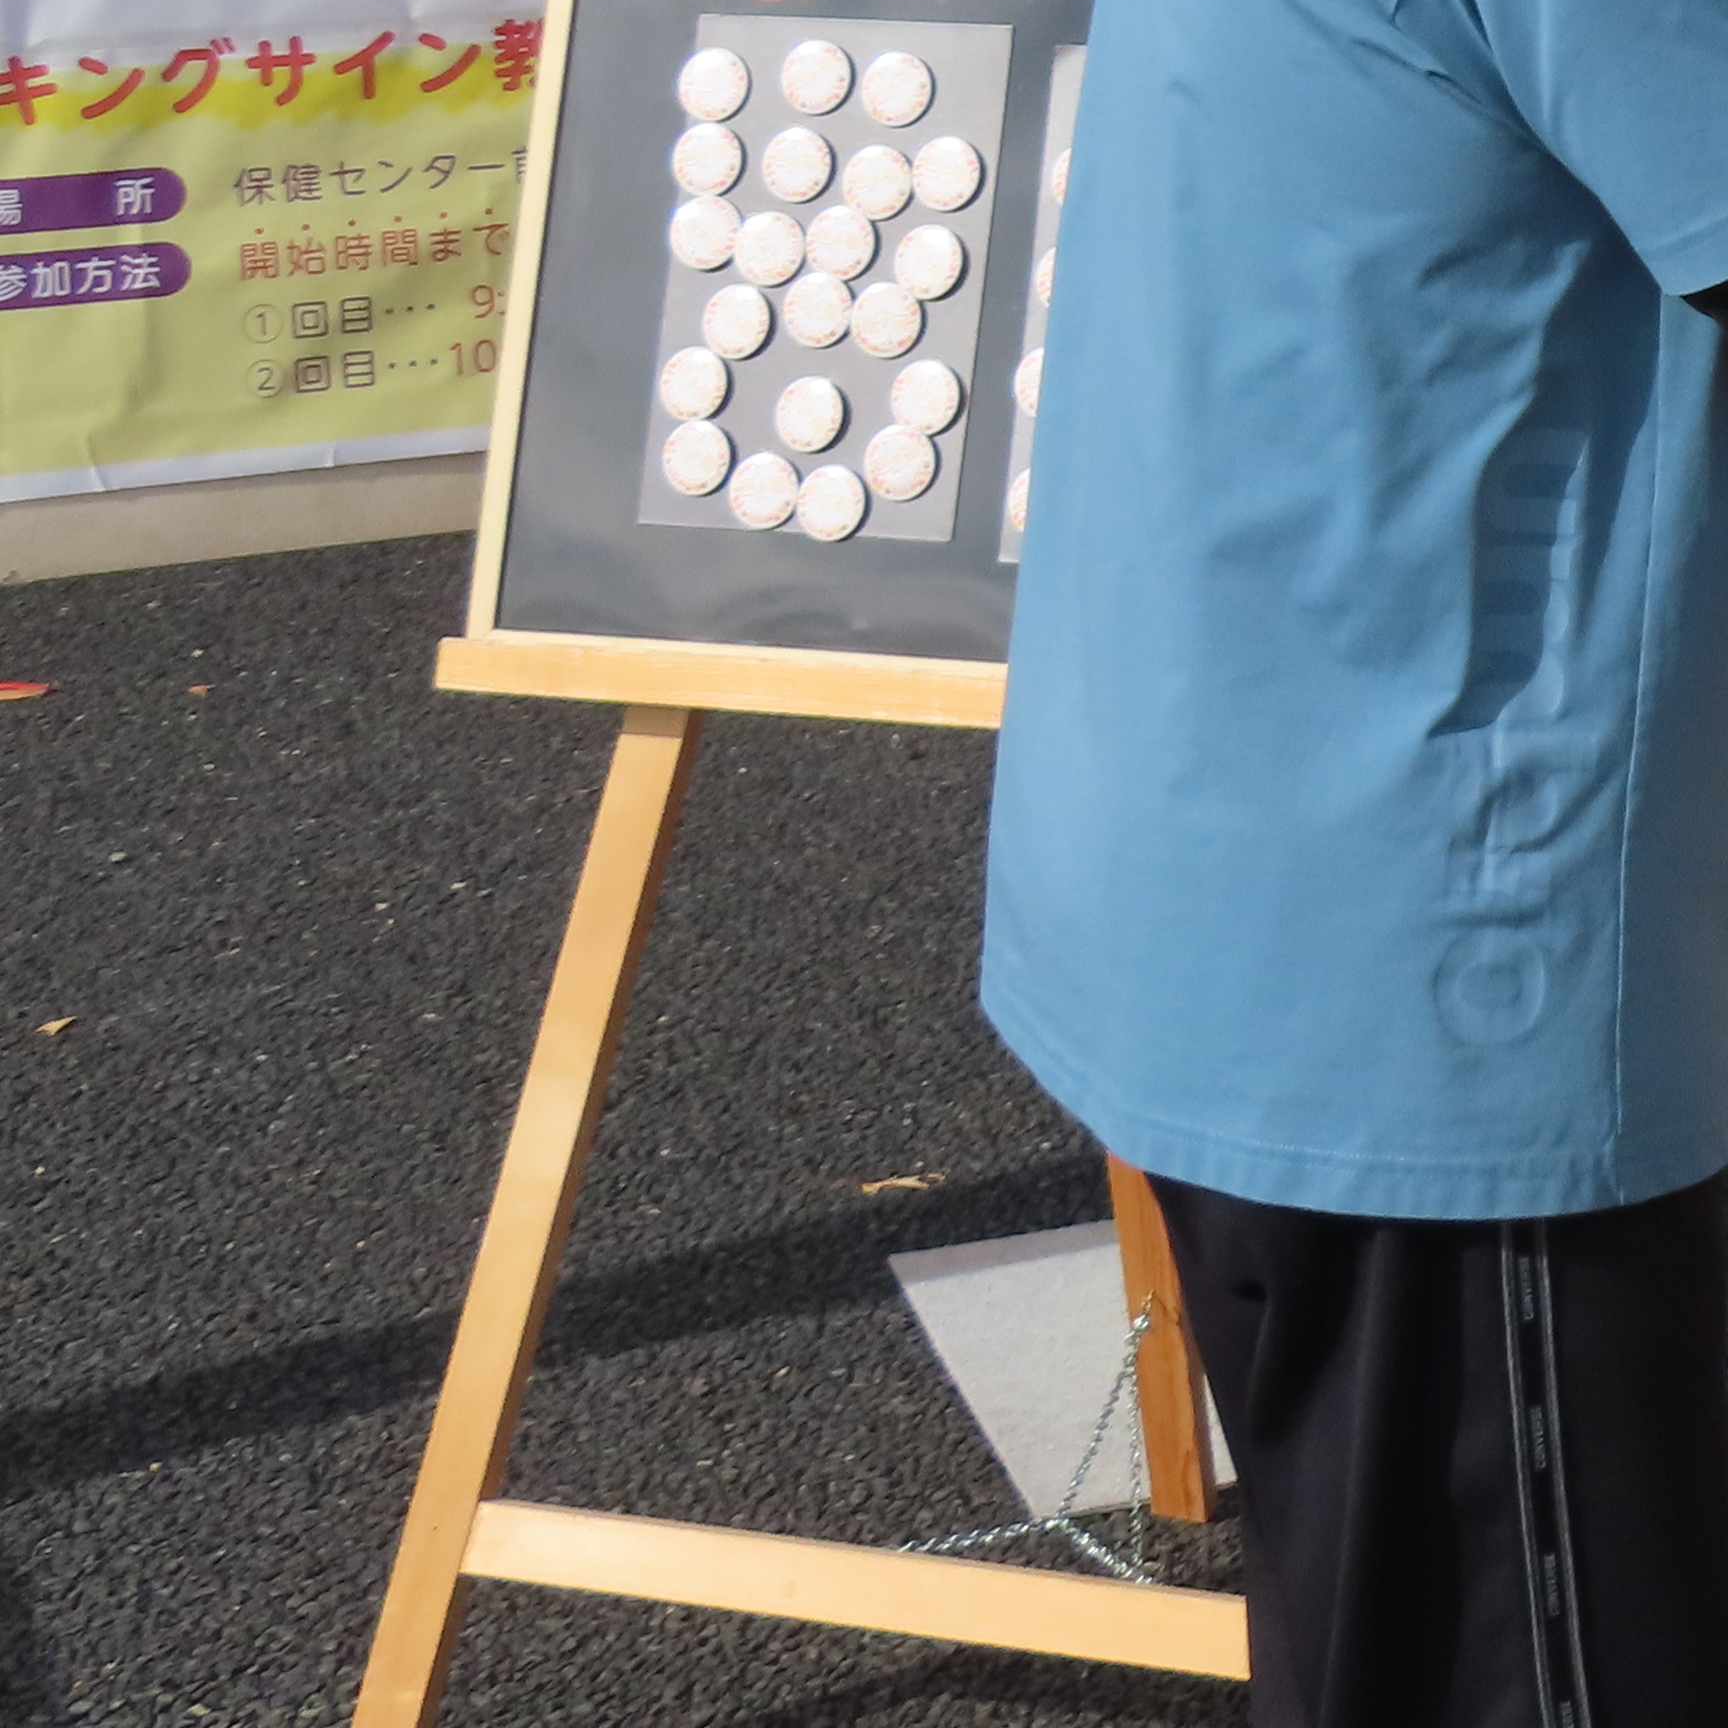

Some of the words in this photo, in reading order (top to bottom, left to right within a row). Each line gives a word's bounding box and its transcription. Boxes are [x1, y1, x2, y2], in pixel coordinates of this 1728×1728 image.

[113, 176, 156, 215] 所
[0, 252, 161, 303] 参加方法
